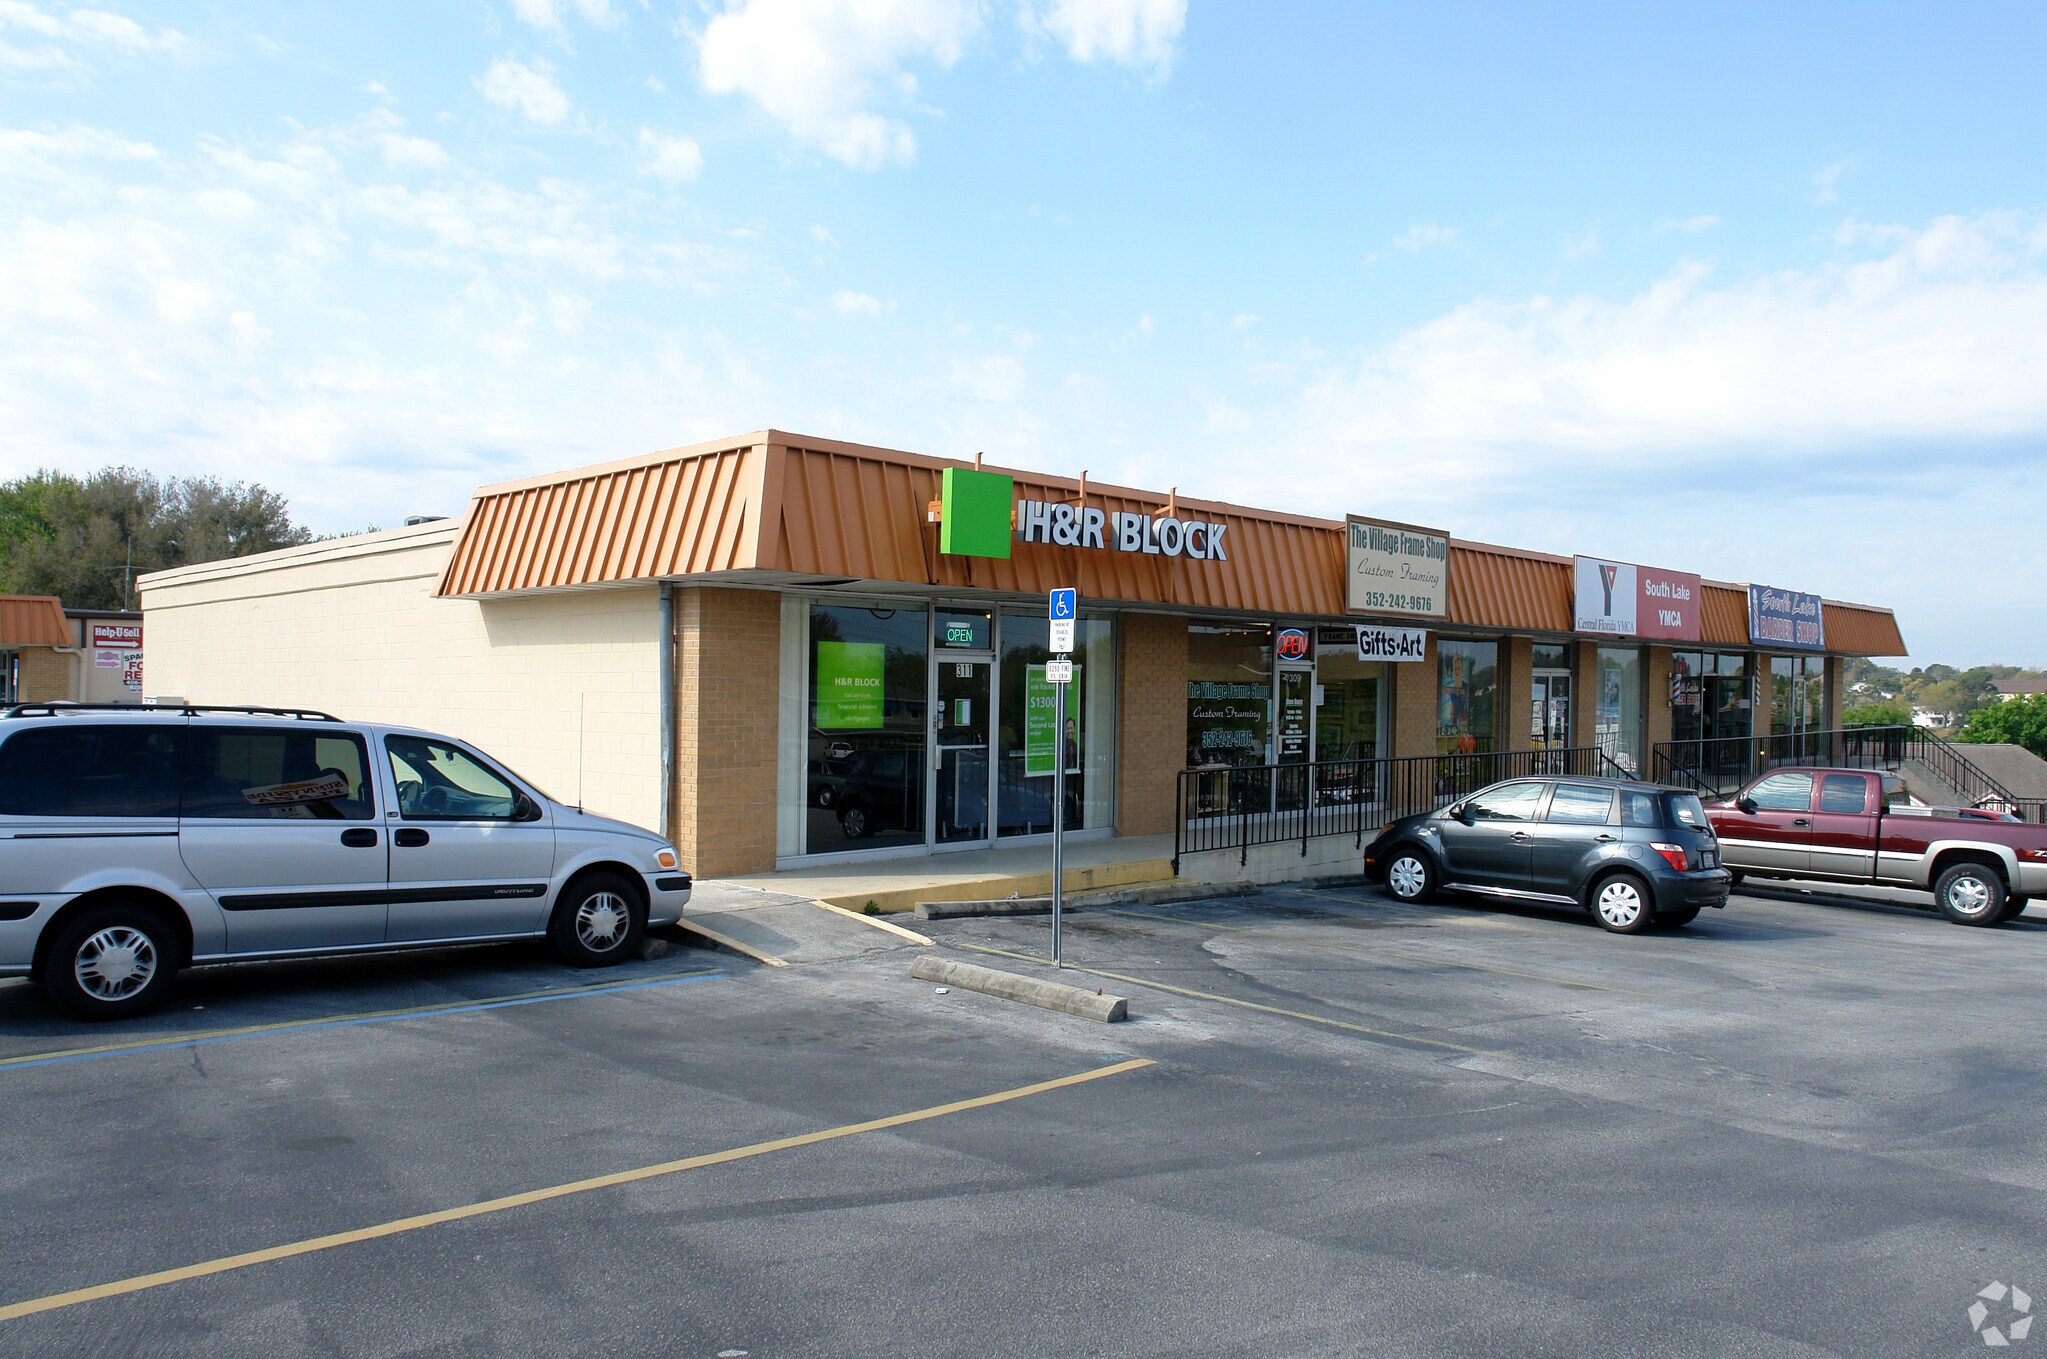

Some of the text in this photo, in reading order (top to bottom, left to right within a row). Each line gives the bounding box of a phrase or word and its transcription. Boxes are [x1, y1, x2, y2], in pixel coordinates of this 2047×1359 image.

[1017, 499, 1228, 561] H&R BLOCK
[1350, 524, 1445, 562] The Village Frame Shop
[1357, 557, 1440, 588] Custom Framing
[1645, 579, 1691, 601] South Lake
[1365, 591, 1432, 611] 352-242-9676
[1760, 589, 1816, 616] South Lake
[1577, 616, 1635, 633] Central Florida YMCA
[1658, 609, 1682, 627] YMCA
[947, 629, 973, 642] OPEN
[1760, 615, 1819, 644] BARBER SHOP
[1276, 635, 1308, 654] OPEN
[124, 653, 143, 662] SPA
[957, 664, 972, 677] 311
[835, 677, 880, 686] H&R BLOCK
[1200, 681, 1227, 700] Village
[1227, 682, 1251, 699] Frame
[1251, 683, 1269, 700] Shop
[1030, 696, 1056, 708] $1300
[1193, 706, 1261, 723] Custom Framing
